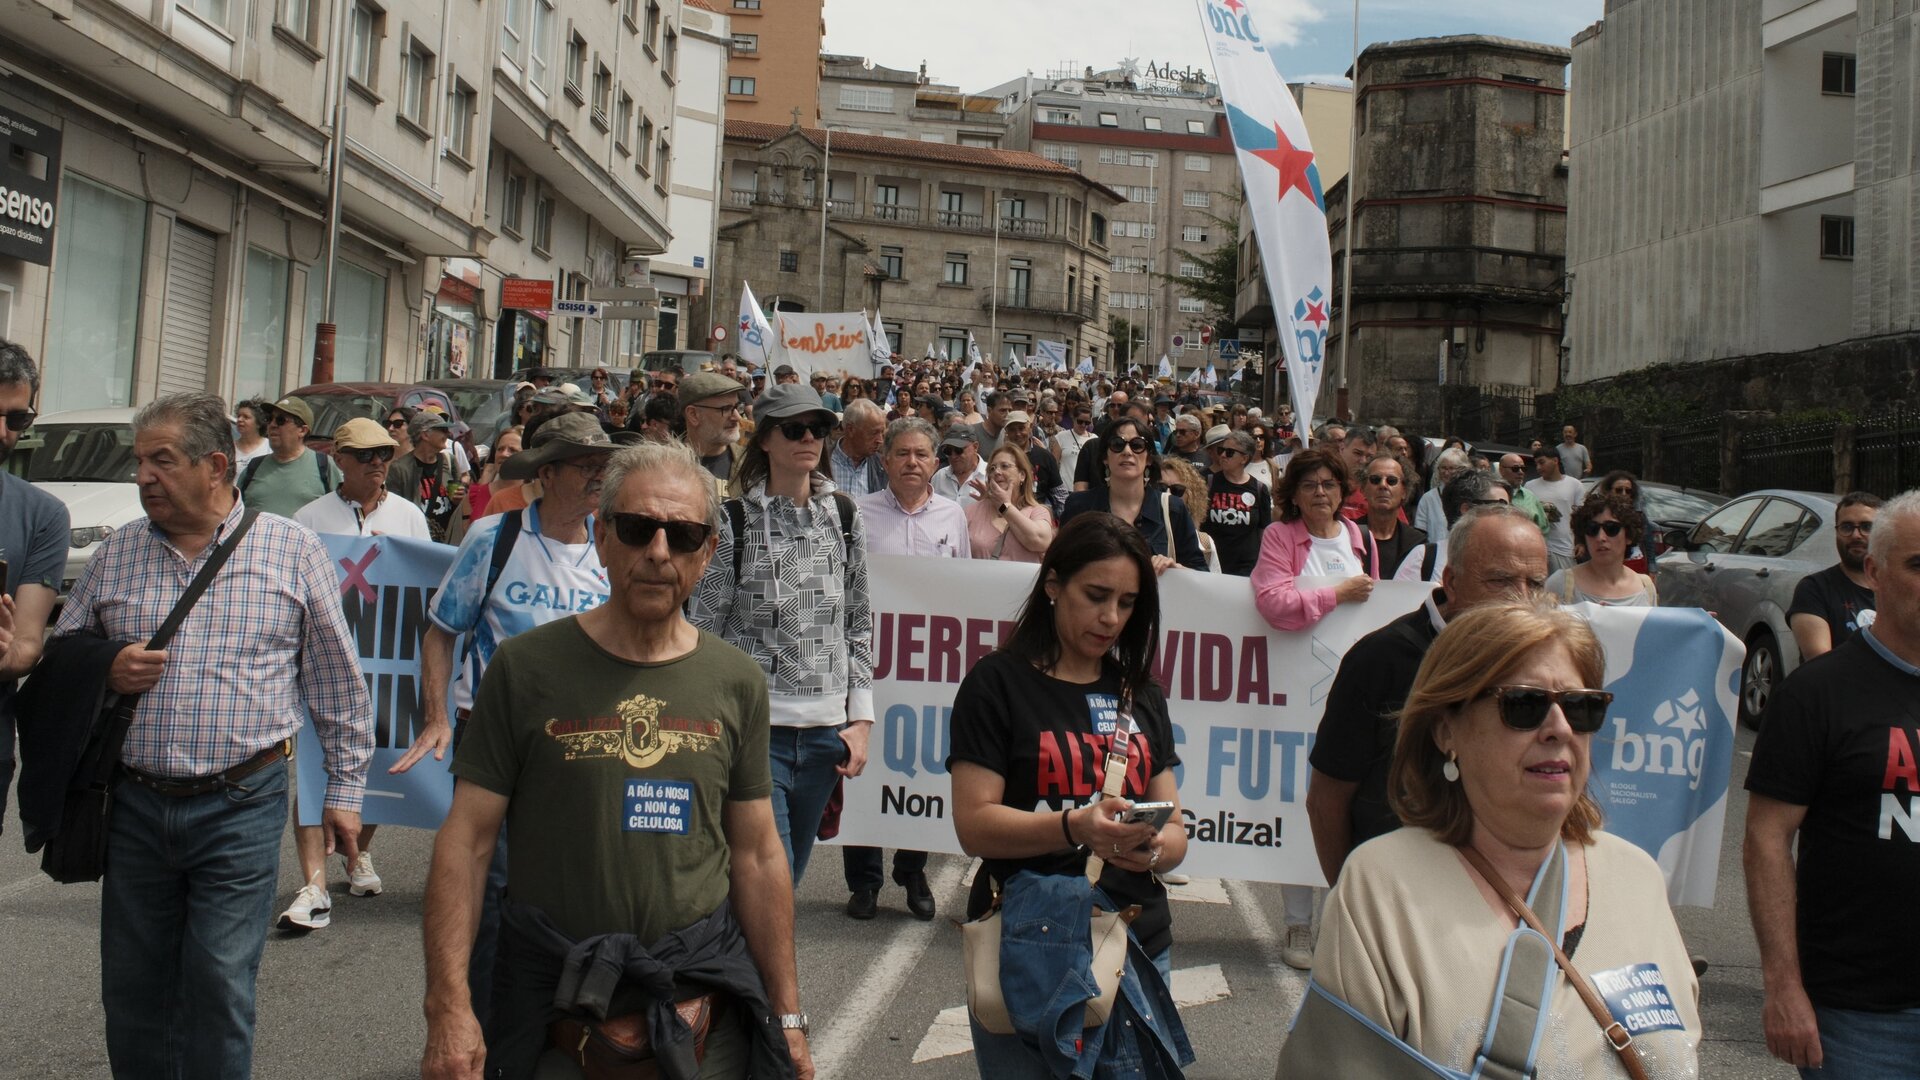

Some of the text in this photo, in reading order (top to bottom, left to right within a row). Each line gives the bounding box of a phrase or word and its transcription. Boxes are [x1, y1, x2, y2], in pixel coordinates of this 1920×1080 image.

[1145, 59, 1206, 85] Adeslas
[558, 302, 585, 311] asisa
[1210, 508, 1250, 525] NON
[1151, 630, 1287, 706] VIDA.
[1611, 717, 1706, 790] bng
[627, 783, 689, 800] A RÍA é NOSA
[1610, 782, 1637, 791] BLOQUE
[1610, 789, 1657, 799] NACIONALISTA
[635, 801, 681, 815] e NON de
[881, 785, 944, 819] Non
[1610, 797, 1637, 805] GALEGO
[629, 816, 683, 831] CELULOSA
[1181, 809, 1282, 847] Galiza!
[1621, 989, 1669, 1010] e NON de
[1625, 1009, 1681, 1031] CELULOSA
